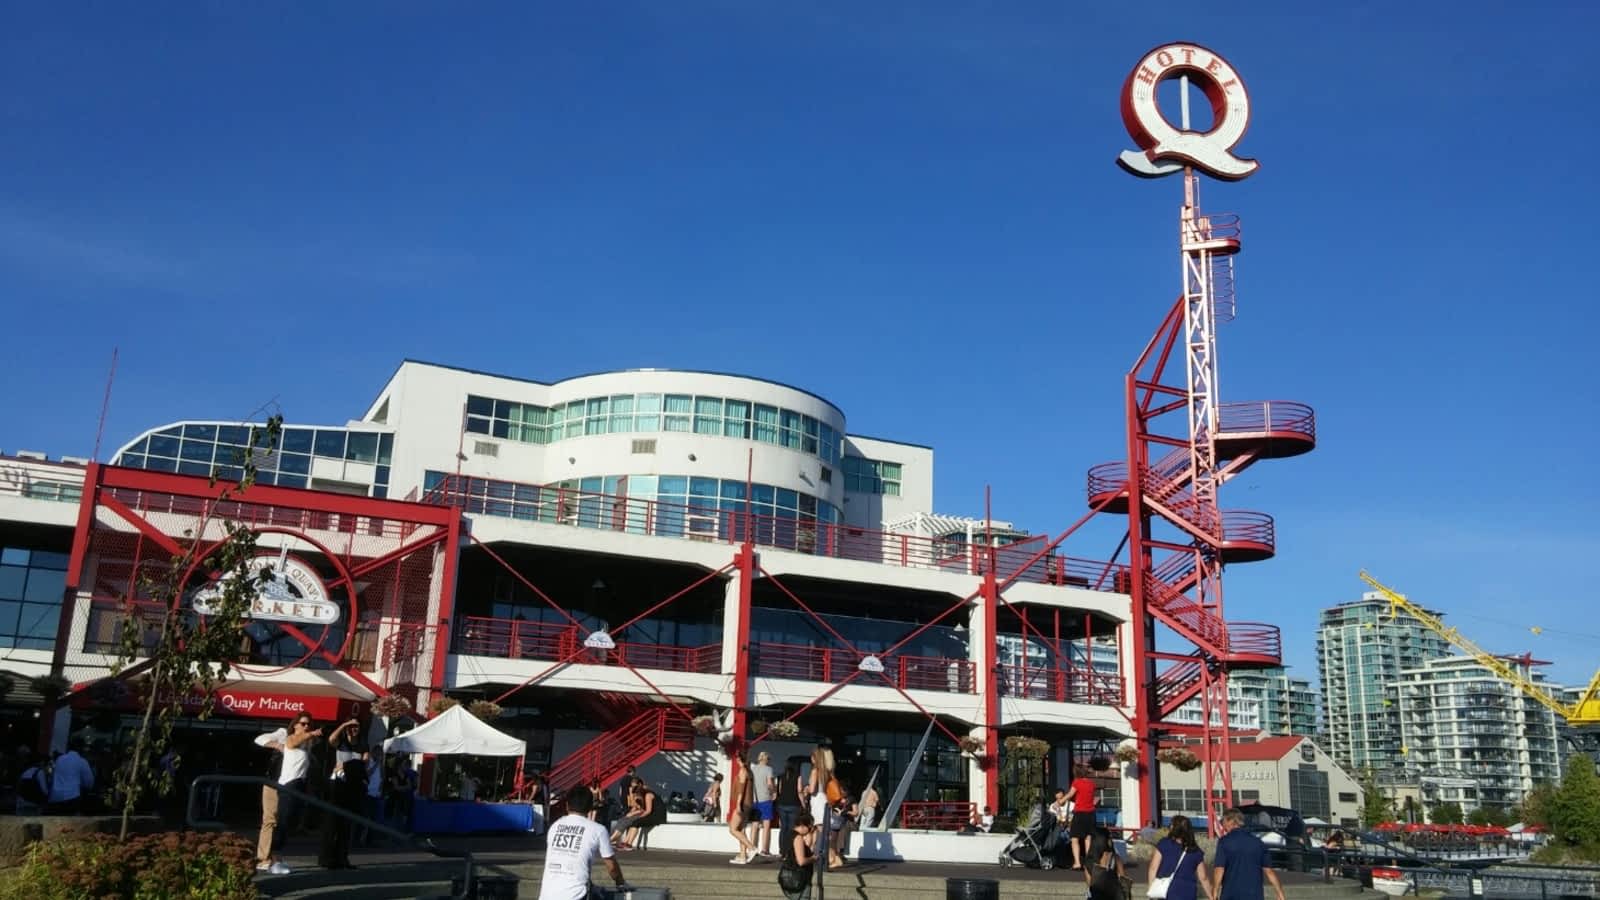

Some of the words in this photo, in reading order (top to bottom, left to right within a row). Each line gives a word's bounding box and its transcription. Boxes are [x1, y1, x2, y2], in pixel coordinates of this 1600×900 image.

[1137, 48, 1239, 95] HOTEL
[1115, 41, 1261, 182] Q
[222, 694, 254, 712] Quay
[259, 696, 305, 712] Market
[556, 824, 586, 836] SUMMER
[552, 833, 577, 849] FEST
